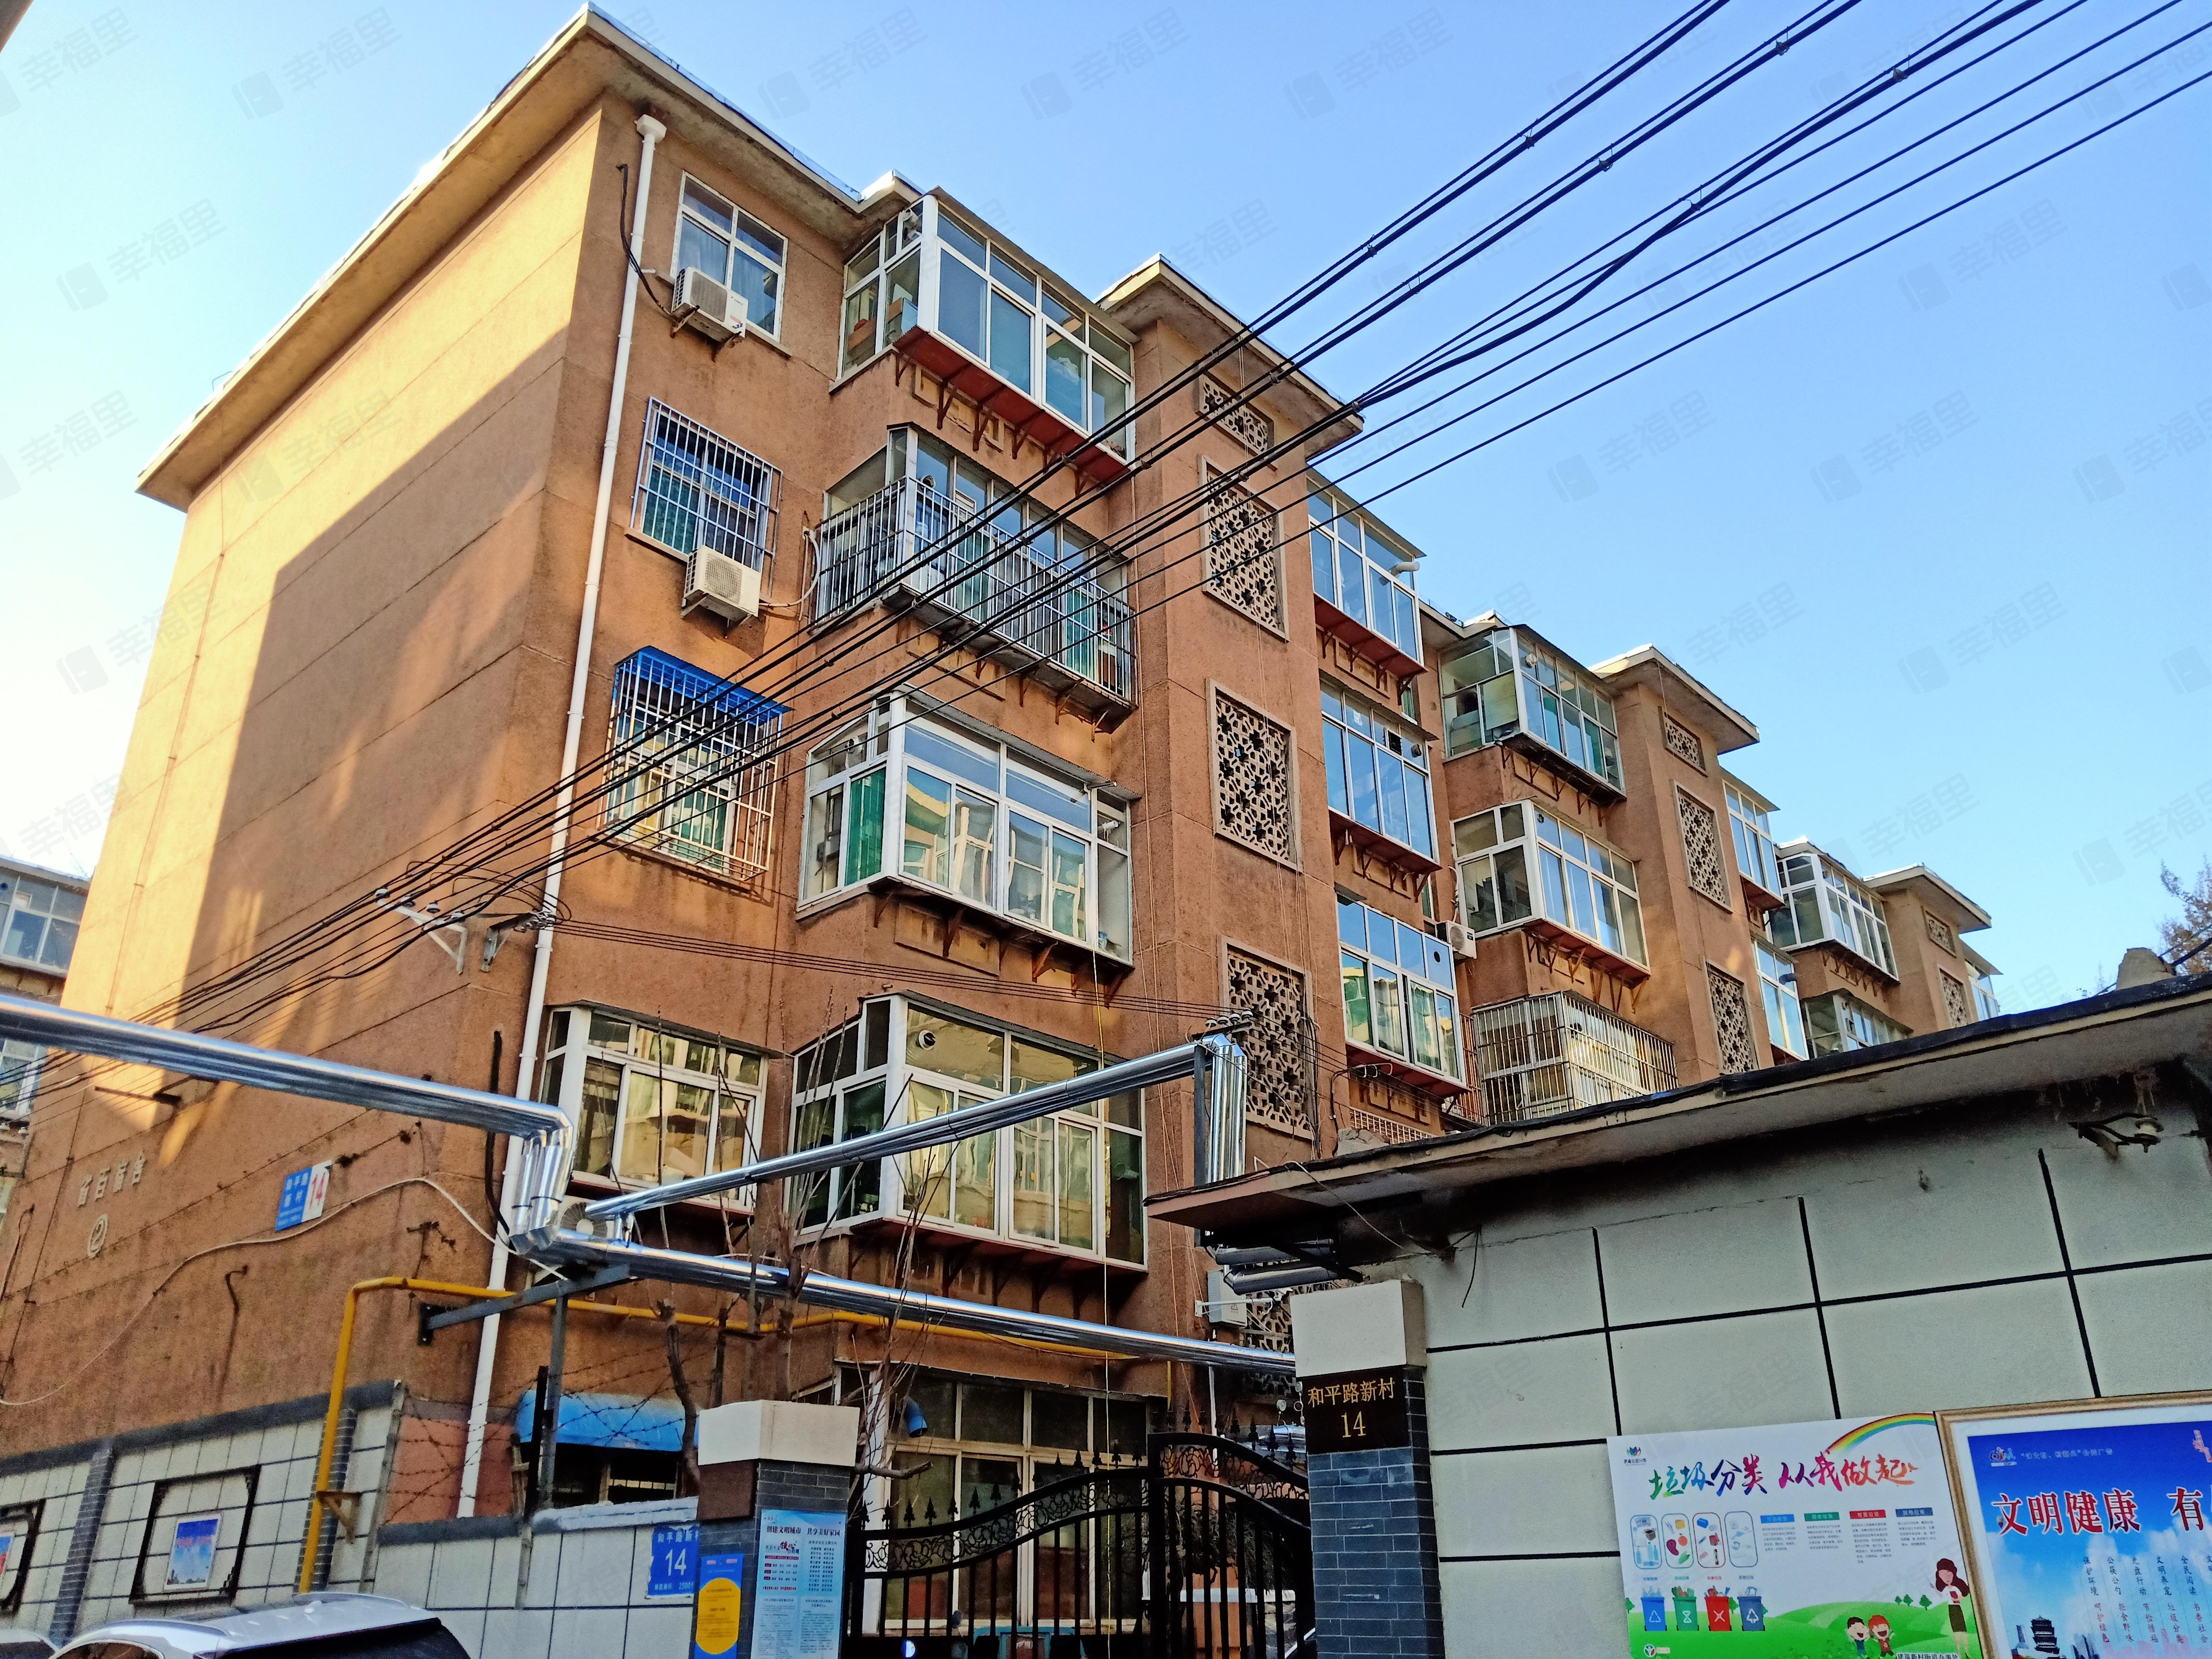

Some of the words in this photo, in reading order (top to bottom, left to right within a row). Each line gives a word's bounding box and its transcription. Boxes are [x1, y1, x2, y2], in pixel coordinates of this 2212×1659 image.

[309, 1172, 326, 1209] 14
[1308, 1377, 1395, 1408] 和平路新村
[1341, 1411, 1366, 1438] 14
[1649, 1454, 1767, 1500] 垃圾分类
[1779, 1449, 1920, 1492] 从我做起
[1992, 1488, 2140, 1536] 文明健康
[2168, 1487, 2205, 1532] 有
[665, 1548, 686, 1576] 14
[2084, 1556, 2099, 1595] 保护环境
[2131, 1556, 2146, 1596] 光盘行动
[2107, 1556, 2121, 1595] 公筷公勺
[2119, 1602, 2134, 1642] 拒食野味
[2156, 1555, 2172, 1595] 文明养宠
[2168, 1603, 2184, 1643] 垃圾分类
[2181, 1555, 2196, 1596] 全民阅读
[2193, 1602, 2208, 1643] 书香社会
